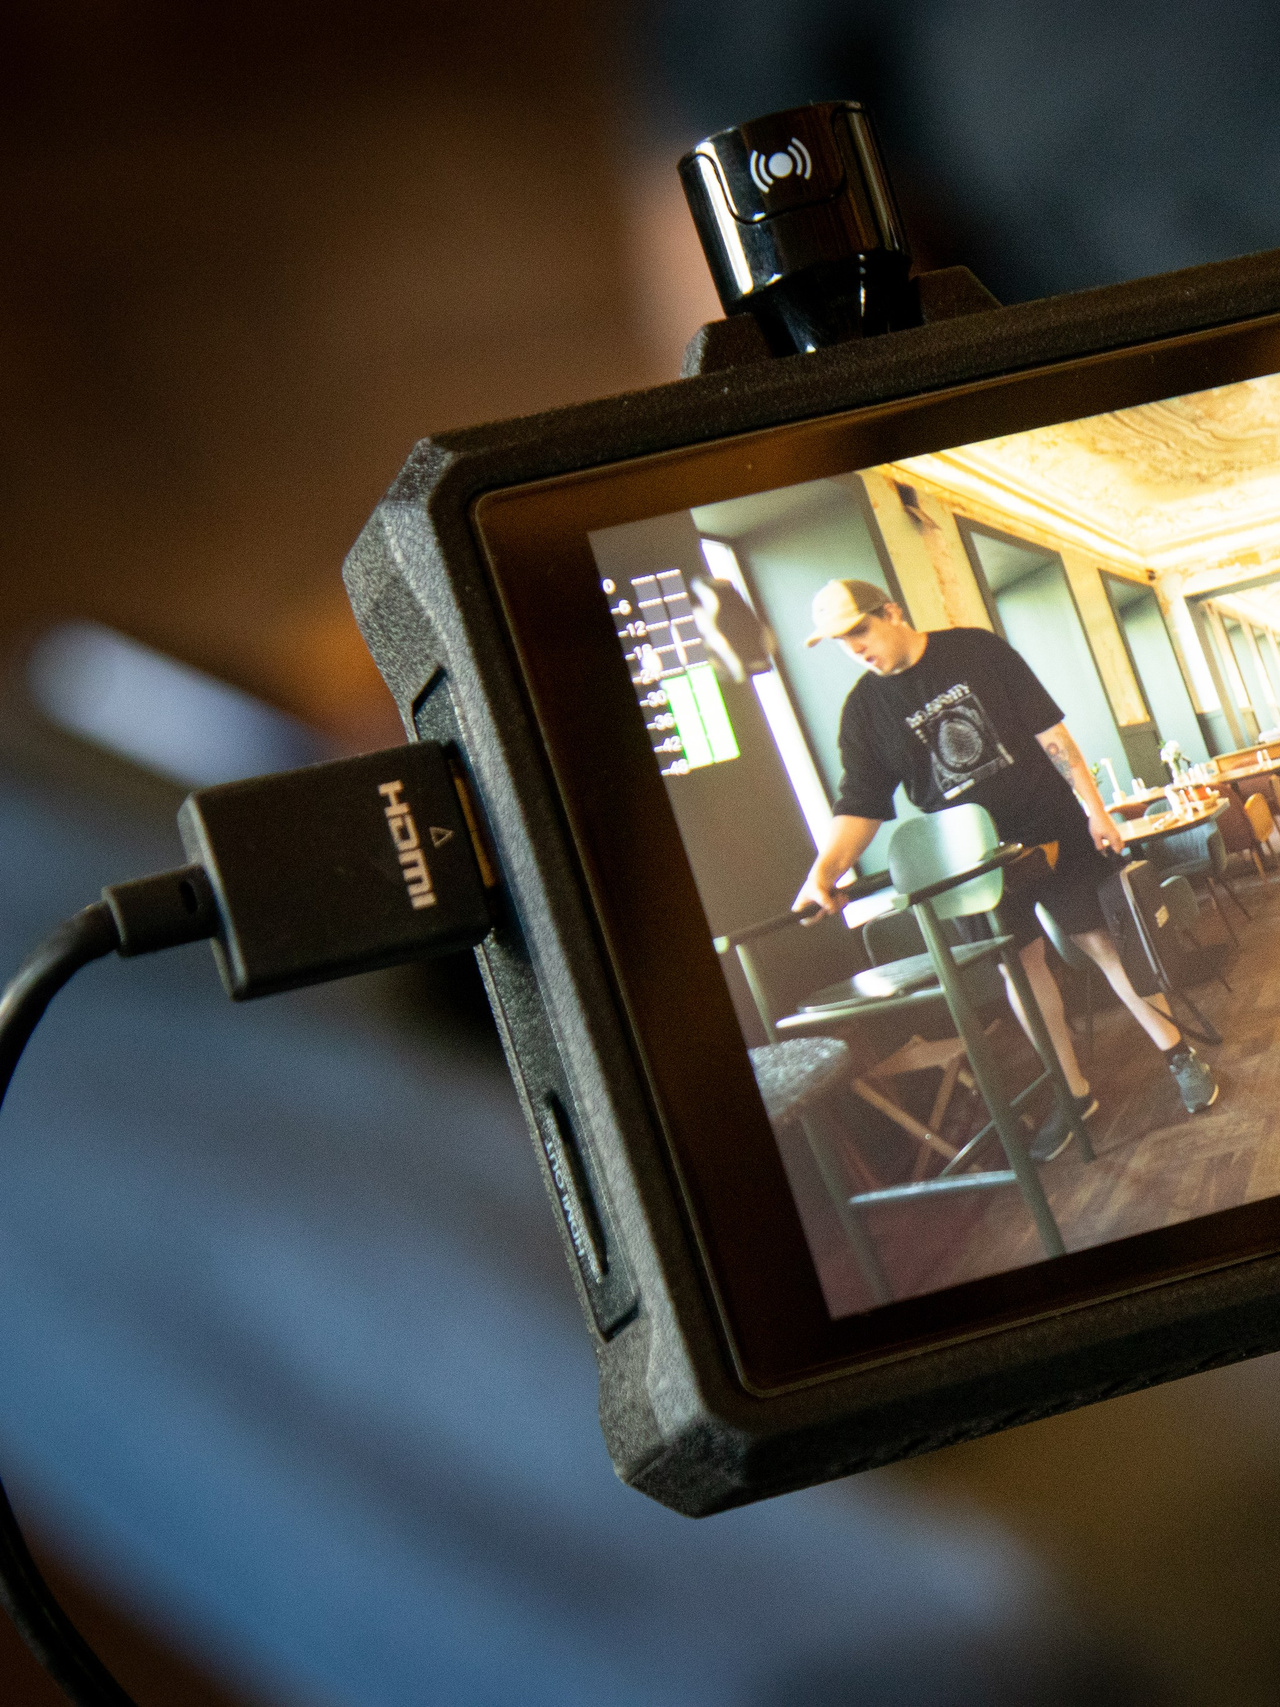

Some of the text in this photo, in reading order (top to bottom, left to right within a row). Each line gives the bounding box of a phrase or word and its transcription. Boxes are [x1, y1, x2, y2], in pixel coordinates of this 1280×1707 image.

[602, 578, 616, 595] 0
[611, 599, 632, 616] -6
[618, 620, 647, 638] -12
[639, 689, 668, 708] -30
[646, 712, 675, 731] -36
[654, 735, 683, 753] -42
[379, 780, 437, 910] HDMI
